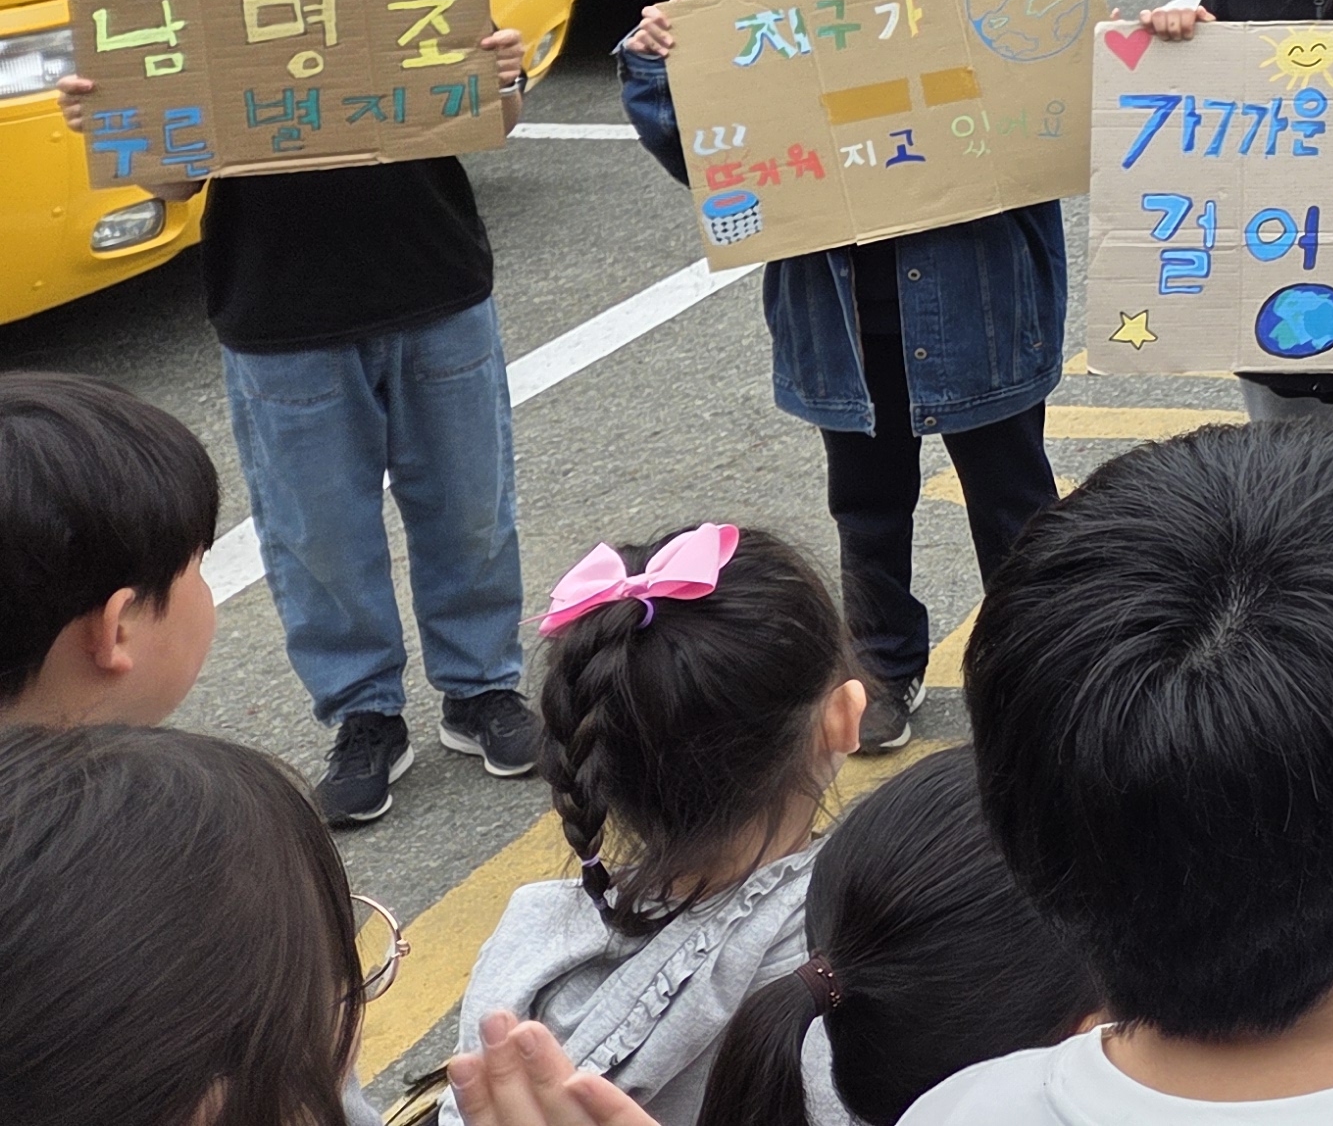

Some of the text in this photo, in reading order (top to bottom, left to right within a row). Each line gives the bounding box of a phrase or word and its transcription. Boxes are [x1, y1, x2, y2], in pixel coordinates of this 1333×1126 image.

[91, 75, 482, 178] 푸른 별지기
[839, 128, 927, 170] 지고
